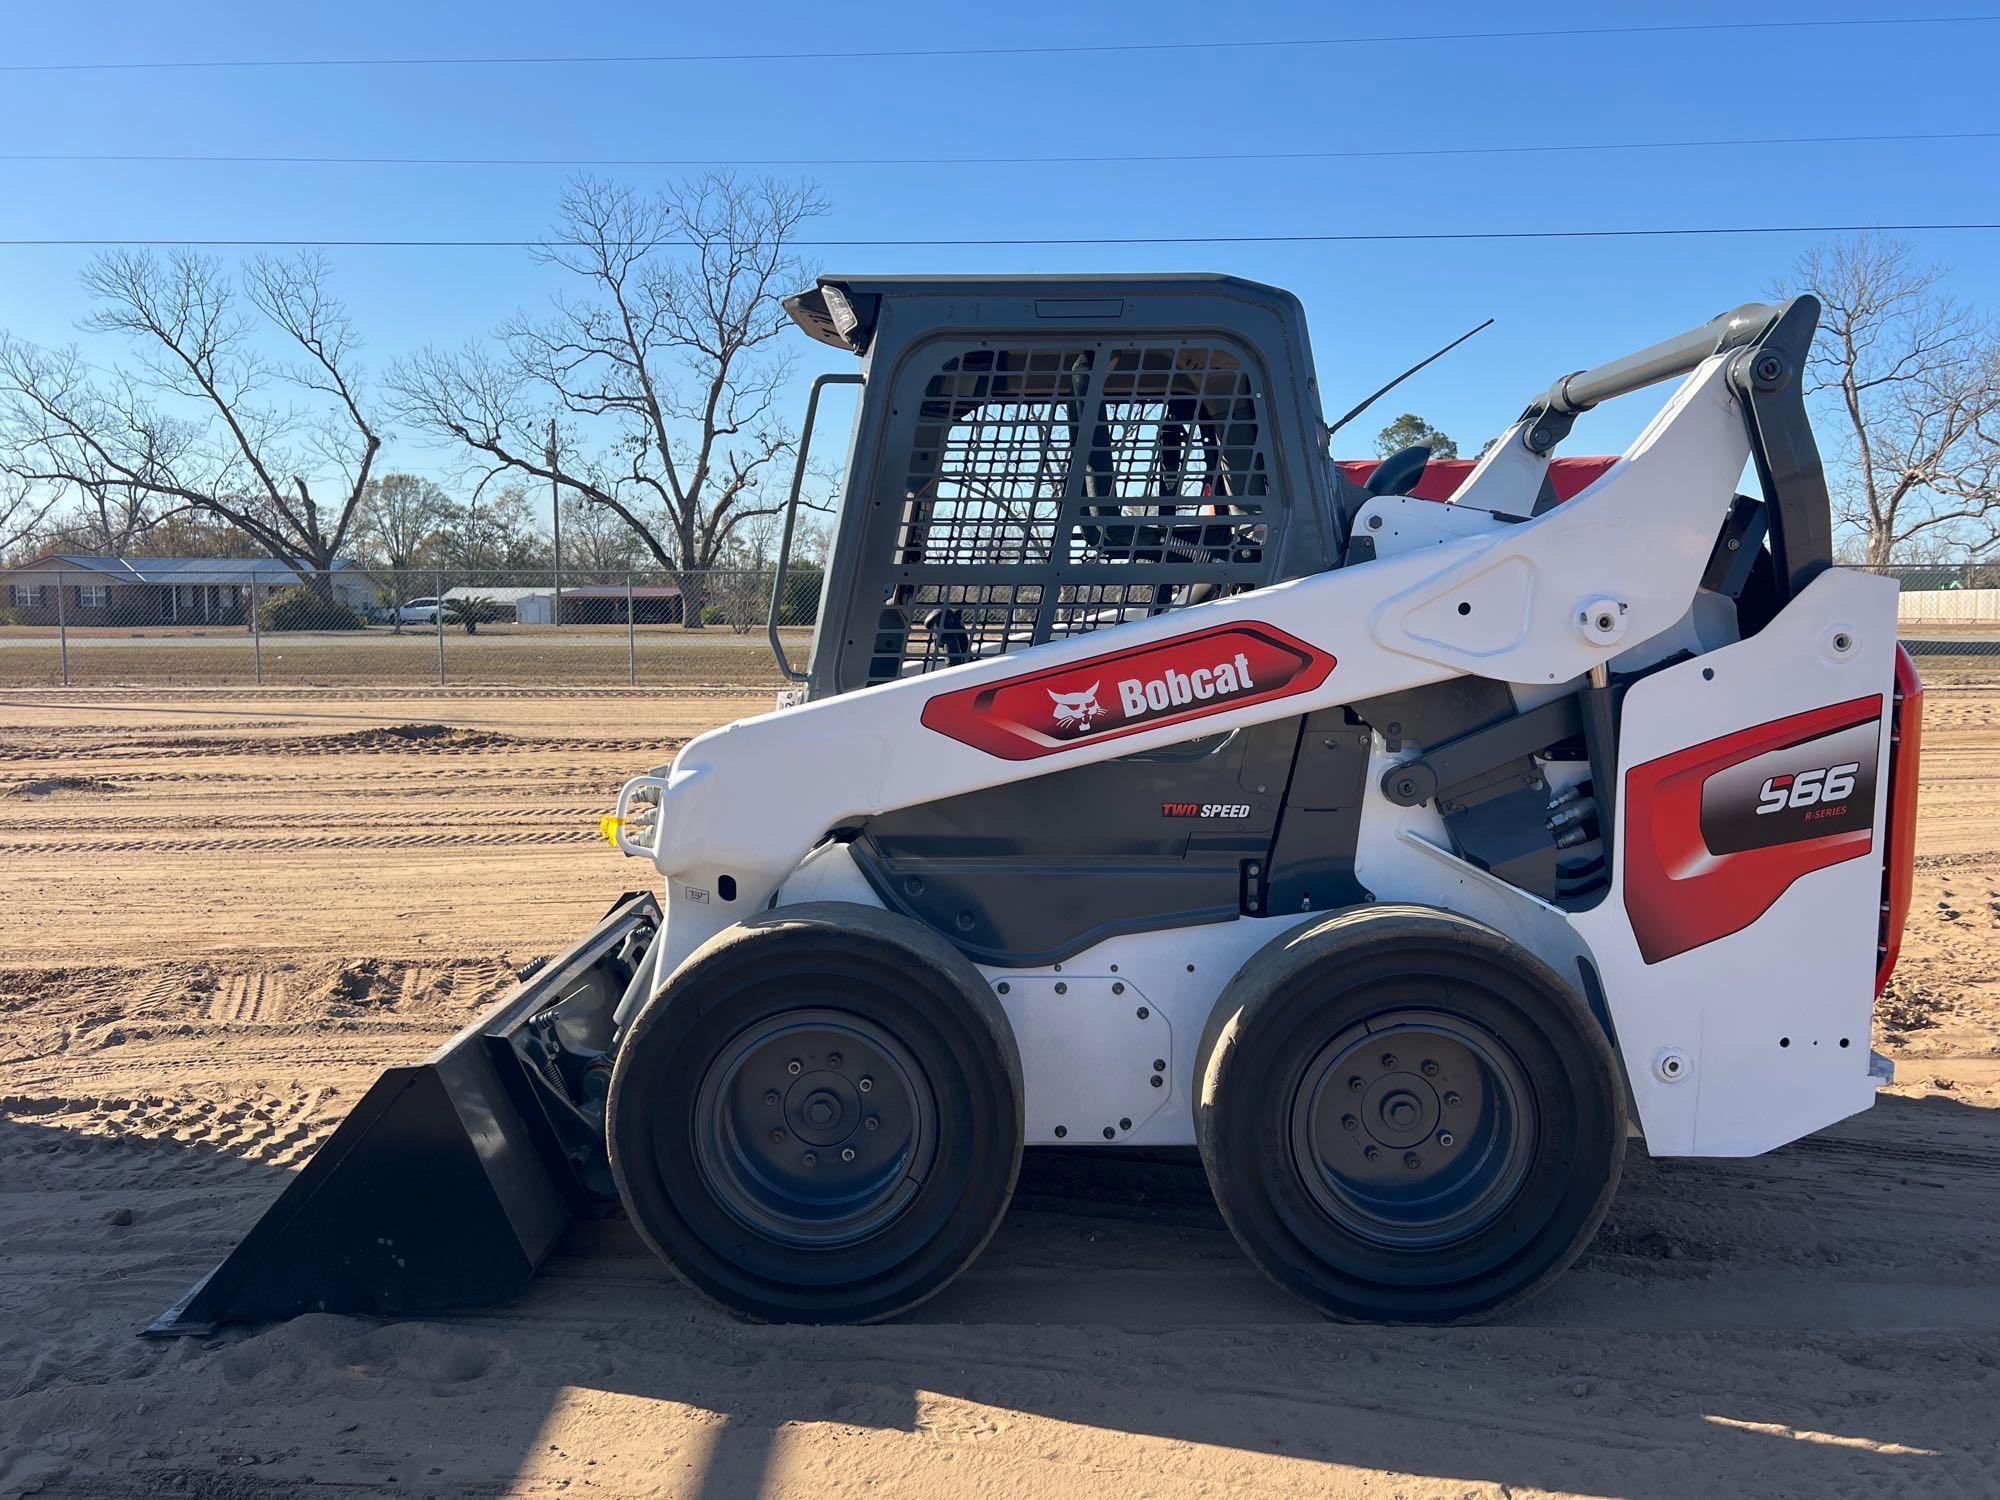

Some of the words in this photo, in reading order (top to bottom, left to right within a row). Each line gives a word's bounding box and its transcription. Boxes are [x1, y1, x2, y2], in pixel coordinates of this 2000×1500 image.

[1117, 652, 1254, 718] Bobcat
[1755, 762, 1860, 815] S66
[1162, 803, 1198, 817] TWO
[1200, 804, 1250, 818] SPEED
[1804, 805, 1848, 821] R-SERIES
